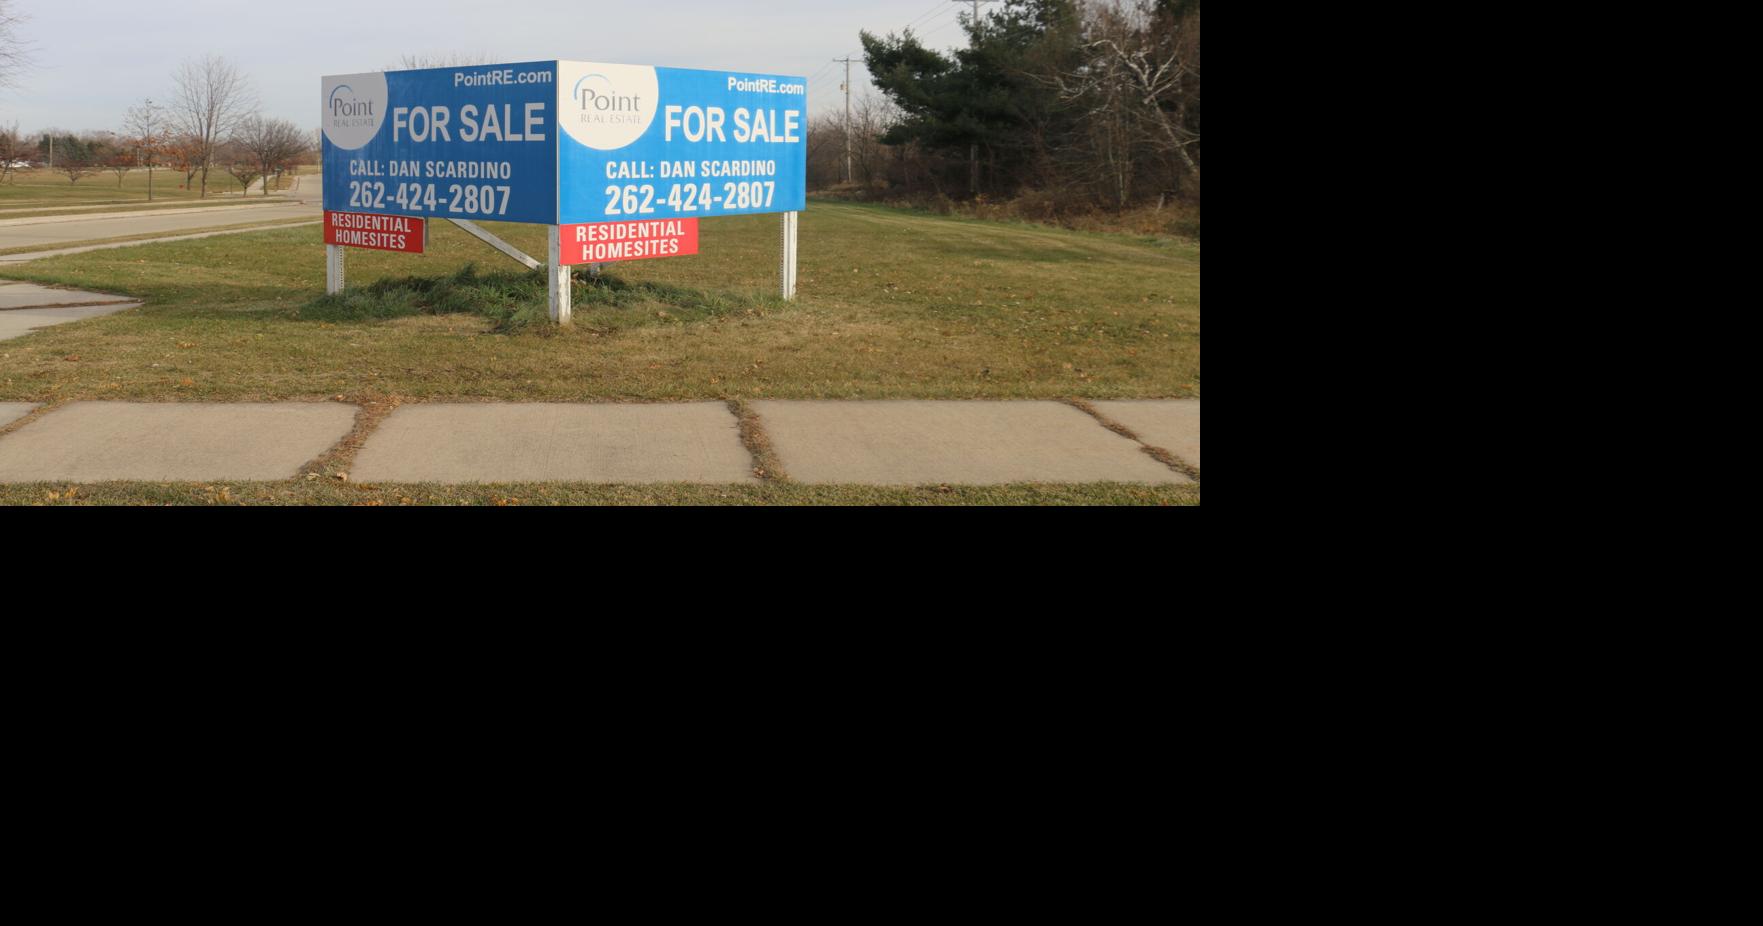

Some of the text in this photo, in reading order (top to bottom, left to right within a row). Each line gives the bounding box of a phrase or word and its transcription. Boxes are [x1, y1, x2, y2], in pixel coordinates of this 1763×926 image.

[454, 69, 552, 87] PointRE.com
[728, 77, 803, 95] PointRE.com
[334, 98, 374, 117] Point
[581, 89, 640, 112] Point
[334, 118, 374, 127] REAL ESTATE
[393, 103, 545, 142] FOR SALE
[581, 114, 641, 124] REAL ESTATE
[665, 105, 799, 143] FOR SALE
[351, 160, 511, 179] CALL: DAN SCARDINO
[606, 160, 775, 178] CALL: DAN SCARDINO
[350, 181, 511, 215] 262-424-2807
[604, 181, 775, 215] 262-424-2807
[332, 213, 411, 232] RESIDENTIAL
[576, 221, 684, 242] RESIDENTIAL
[336, 231, 405, 249] HOMESITES
[582, 238, 678, 261] HOMESITES
